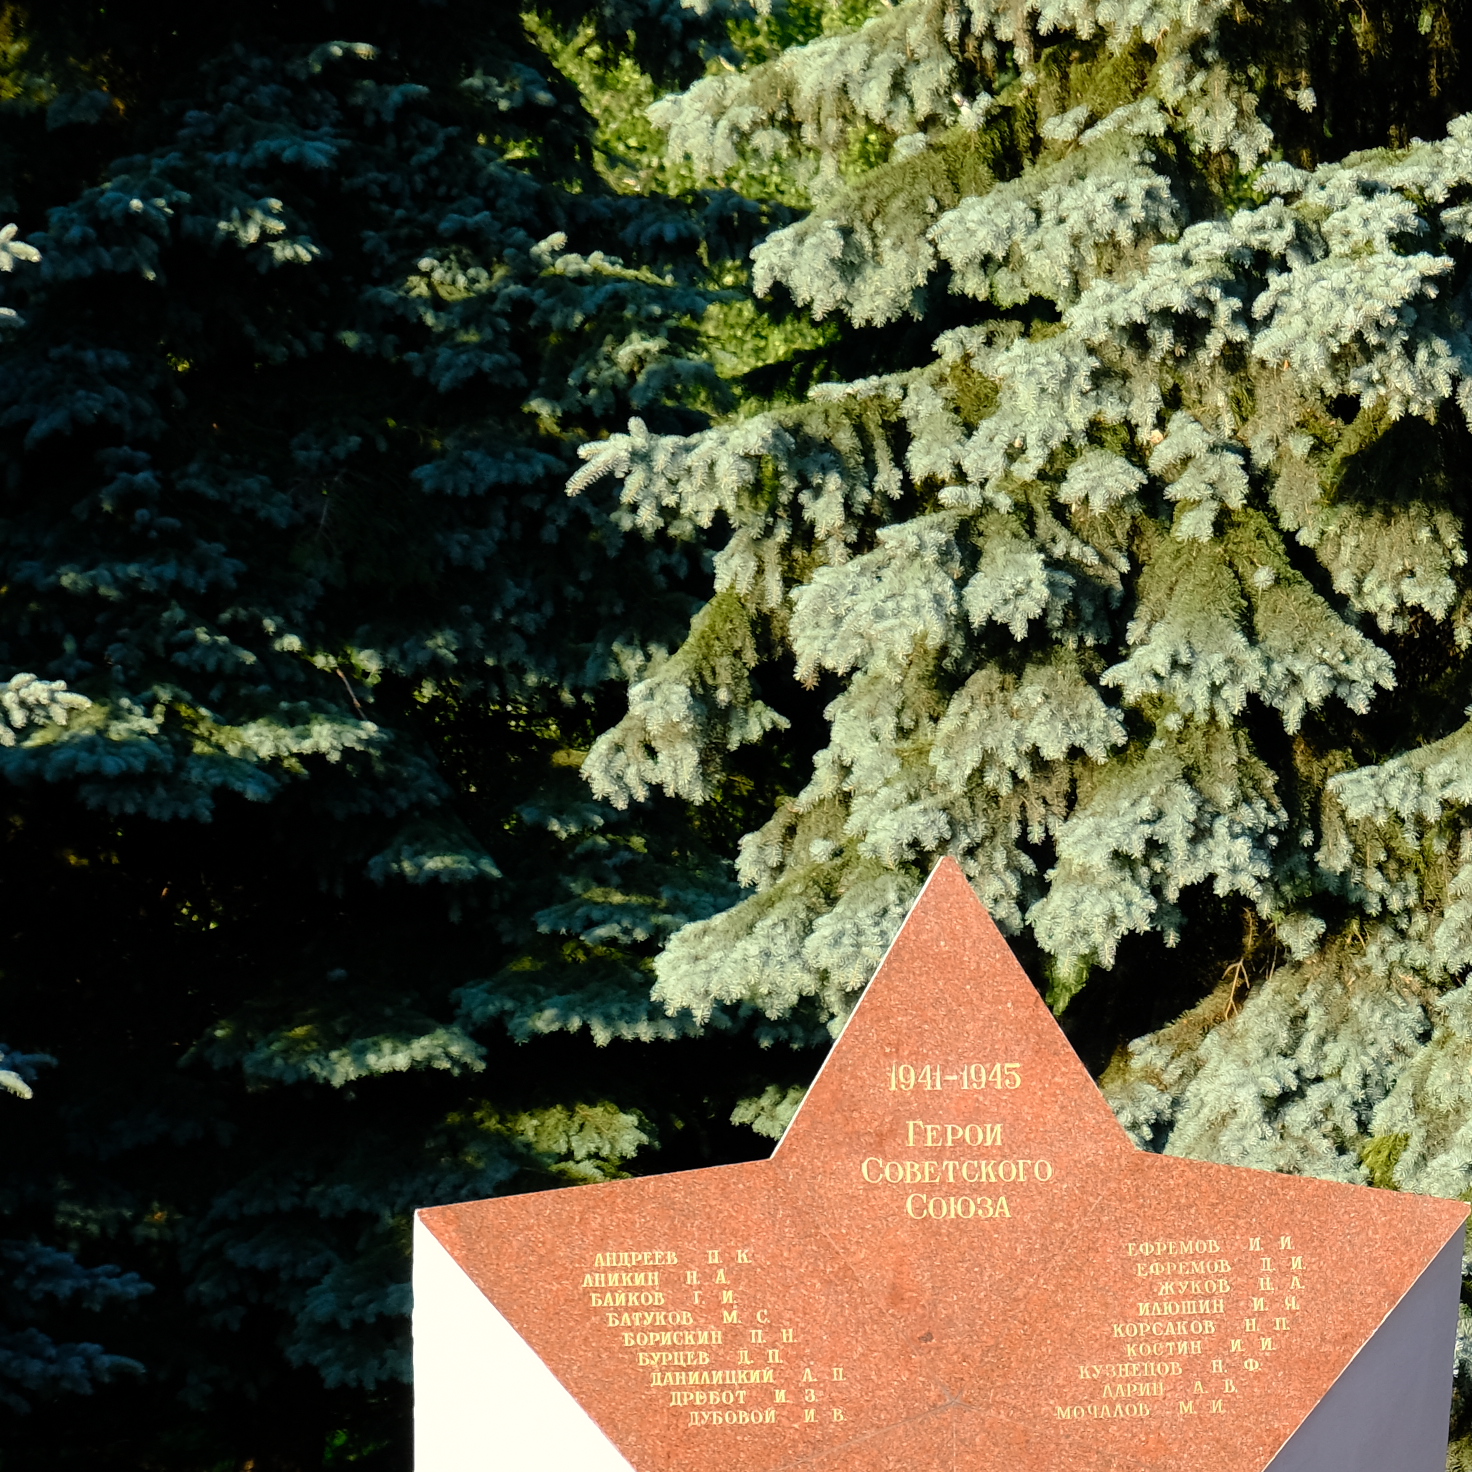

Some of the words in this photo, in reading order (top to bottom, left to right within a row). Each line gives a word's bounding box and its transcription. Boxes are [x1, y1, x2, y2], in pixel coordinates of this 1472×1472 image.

[889, 1062, 1022, 1091] 1941-1945
[906, 1120, 1003, 1147] ГЕРОИ
[861, 1157, 1053, 1184] СОВЕТСКОГО
[906, 1193, 1012, 1220] СОЮЗА
[1128, 1239, 1220, 1256] ЕФРЕМОВ
[594, 1251, 678, 1267] АНДРЕЕВ
[1137, 1259, 1232, 1276] ЕФРЕМОВ
[582, 1272, 660, 1288] АНИКИН
[716, 1268, 730, 1284] А.
[1157, 1279, 1231, 1296] ЖУКОВ
[590, 1291, 664, 1307] БАЙКОВ
[1138, 1299, 1225, 1316] ИЛЮШИН
[606, 1312, 694, 1327] БАТУКОВ
[722, 1310, 742, 1324] М.
[756, 1309, 770, 1324] С.
[622, 1330, 722, 1346] БОРИСКИН
[782, 1328, 797, 1342] Н.
[1113, 1320, 1216, 1338] КОРСАКОВ
[636, 1351, 710, 1366] БУРЦЕВ
[738, 1350, 754, 1365] Д.
[1126, 1341, 1202, 1357] КОСТИН
[650, 1368, 774, 1387] ДАНИЛИЦКИЙ
[1079, 1361, 1183, 1379] КУЗНЕЦОВ
[1243, 1358, 1262, 1372] Ф.
[688, 1408, 776, 1427] ДУБОВОЙ
[1056, 1403, 1150, 1420] МОЧАЛОВ
